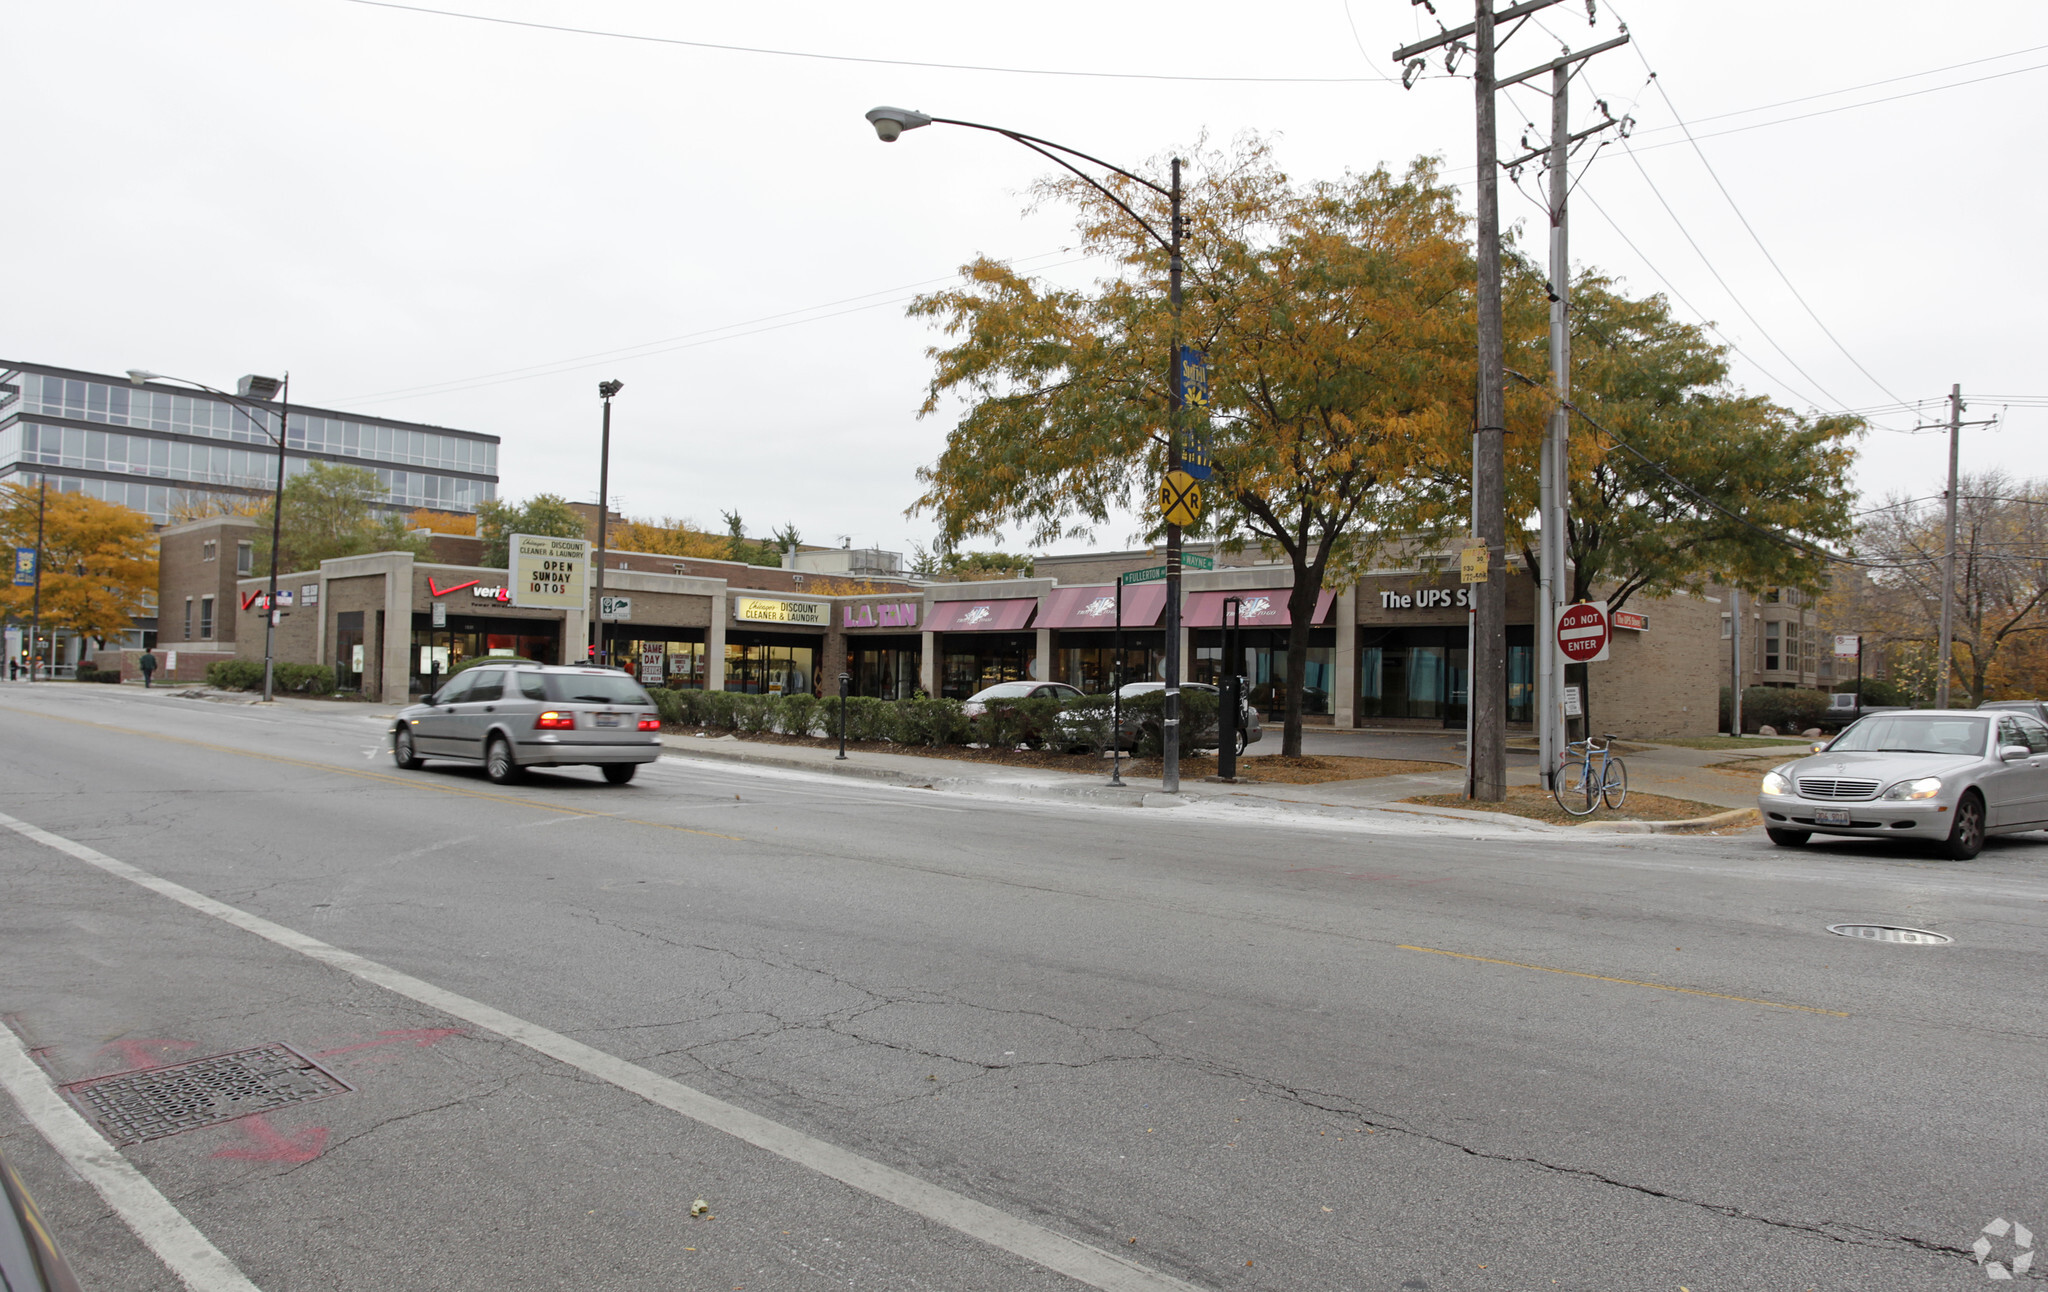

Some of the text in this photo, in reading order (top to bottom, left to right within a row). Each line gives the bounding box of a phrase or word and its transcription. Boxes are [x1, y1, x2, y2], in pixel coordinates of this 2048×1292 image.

[519, 546, 547, 556] CLEANER
[555, 550, 584, 559] LAUNDRY
[551, 541, 584, 551] DISCOUNT
[543, 560, 573, 572] OPEN
[1186, 555, 1207, 568] WAYNE
[532, 571, 571, 583] SUNDAY
[1129, 569, 1161, 583] FULLERTON
[1380, 591, 1412, 609] The
[1416, 588, 1453, 608] UPS
[780, 602, 818, 614] DISCOUNT
[745, 610, 819, 623] CLEANER & LAUNDRY
[877, 603, 917, 627] TAN
[1563, 613, 1599, 627] DO NOT
[642, 643, 663, 654] SAME
[1568, 639, 1597, 652] ENTER
[644, 655, 660, 665] DAY
